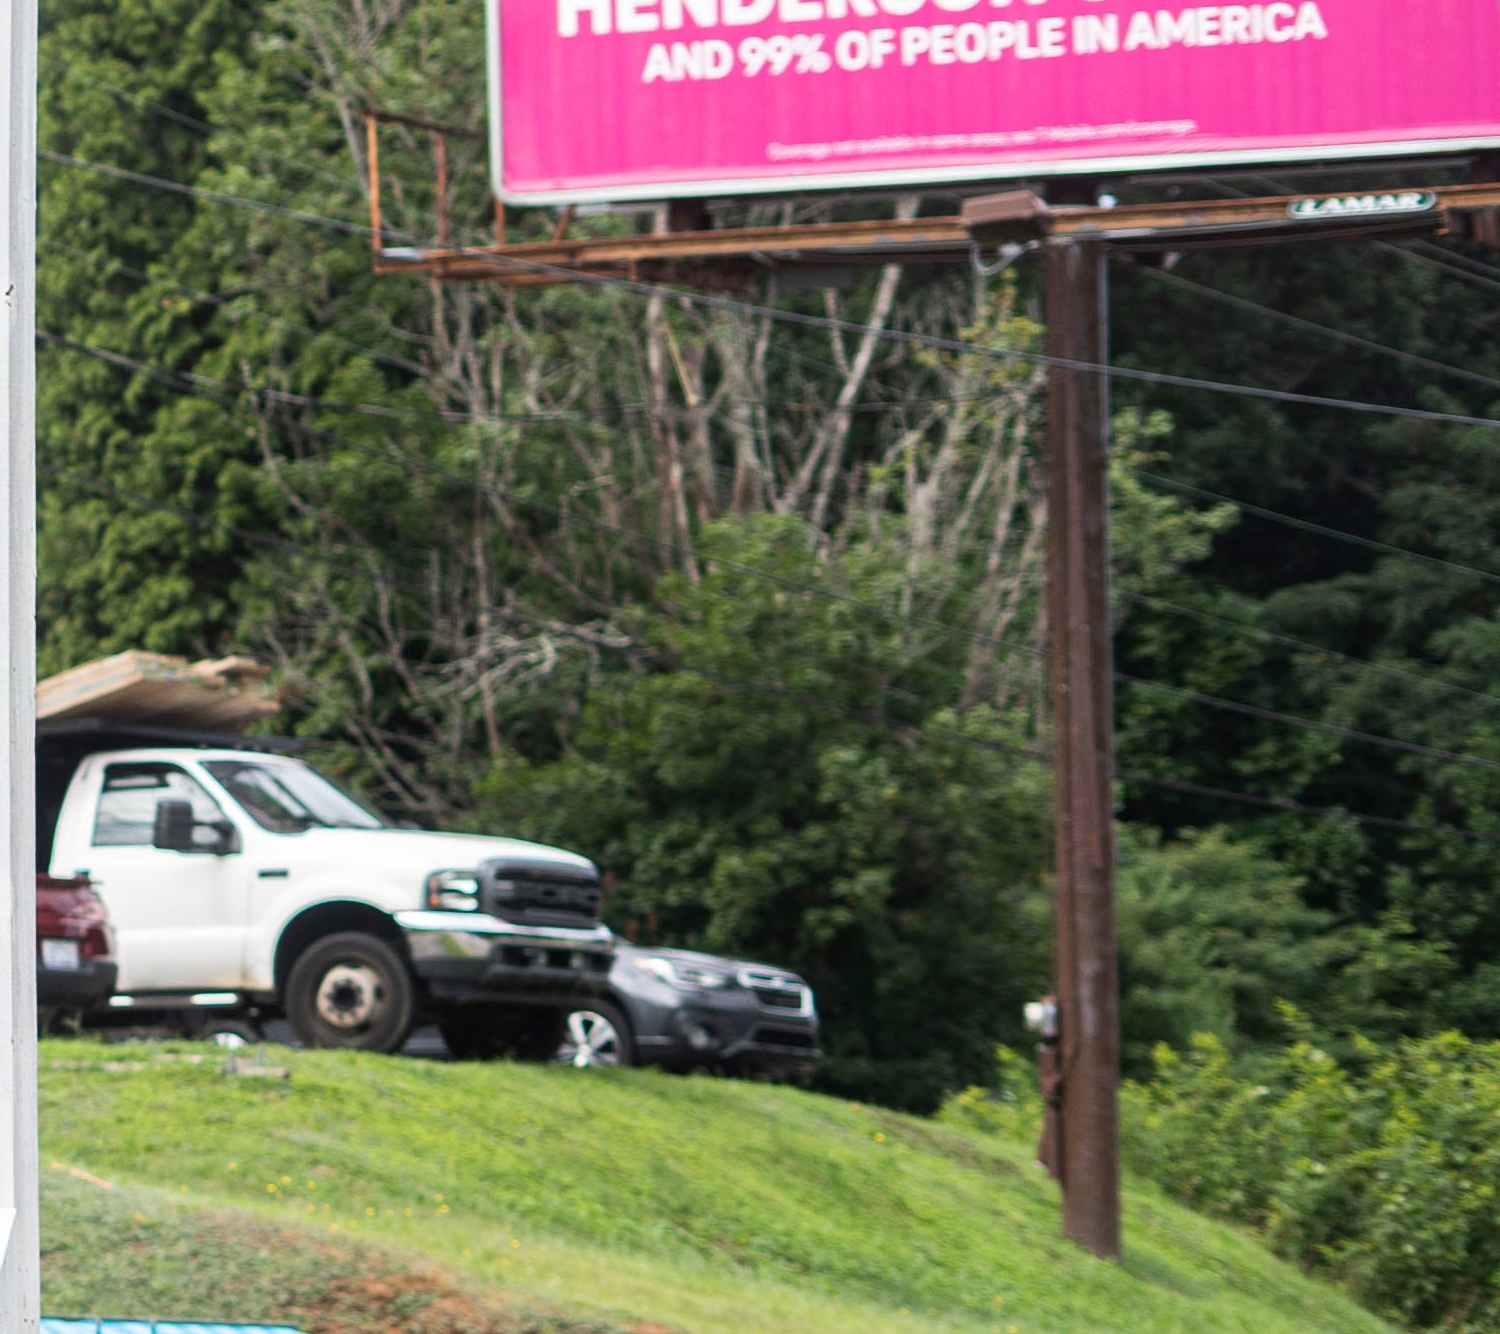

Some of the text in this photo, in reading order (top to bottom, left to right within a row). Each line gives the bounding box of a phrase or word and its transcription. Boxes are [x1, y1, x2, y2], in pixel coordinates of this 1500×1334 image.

[642, 0, 1327, 84] AND 99% OF PEOPLE IN AMERICA
[1300, 192, 1421, 213] LAMAR
